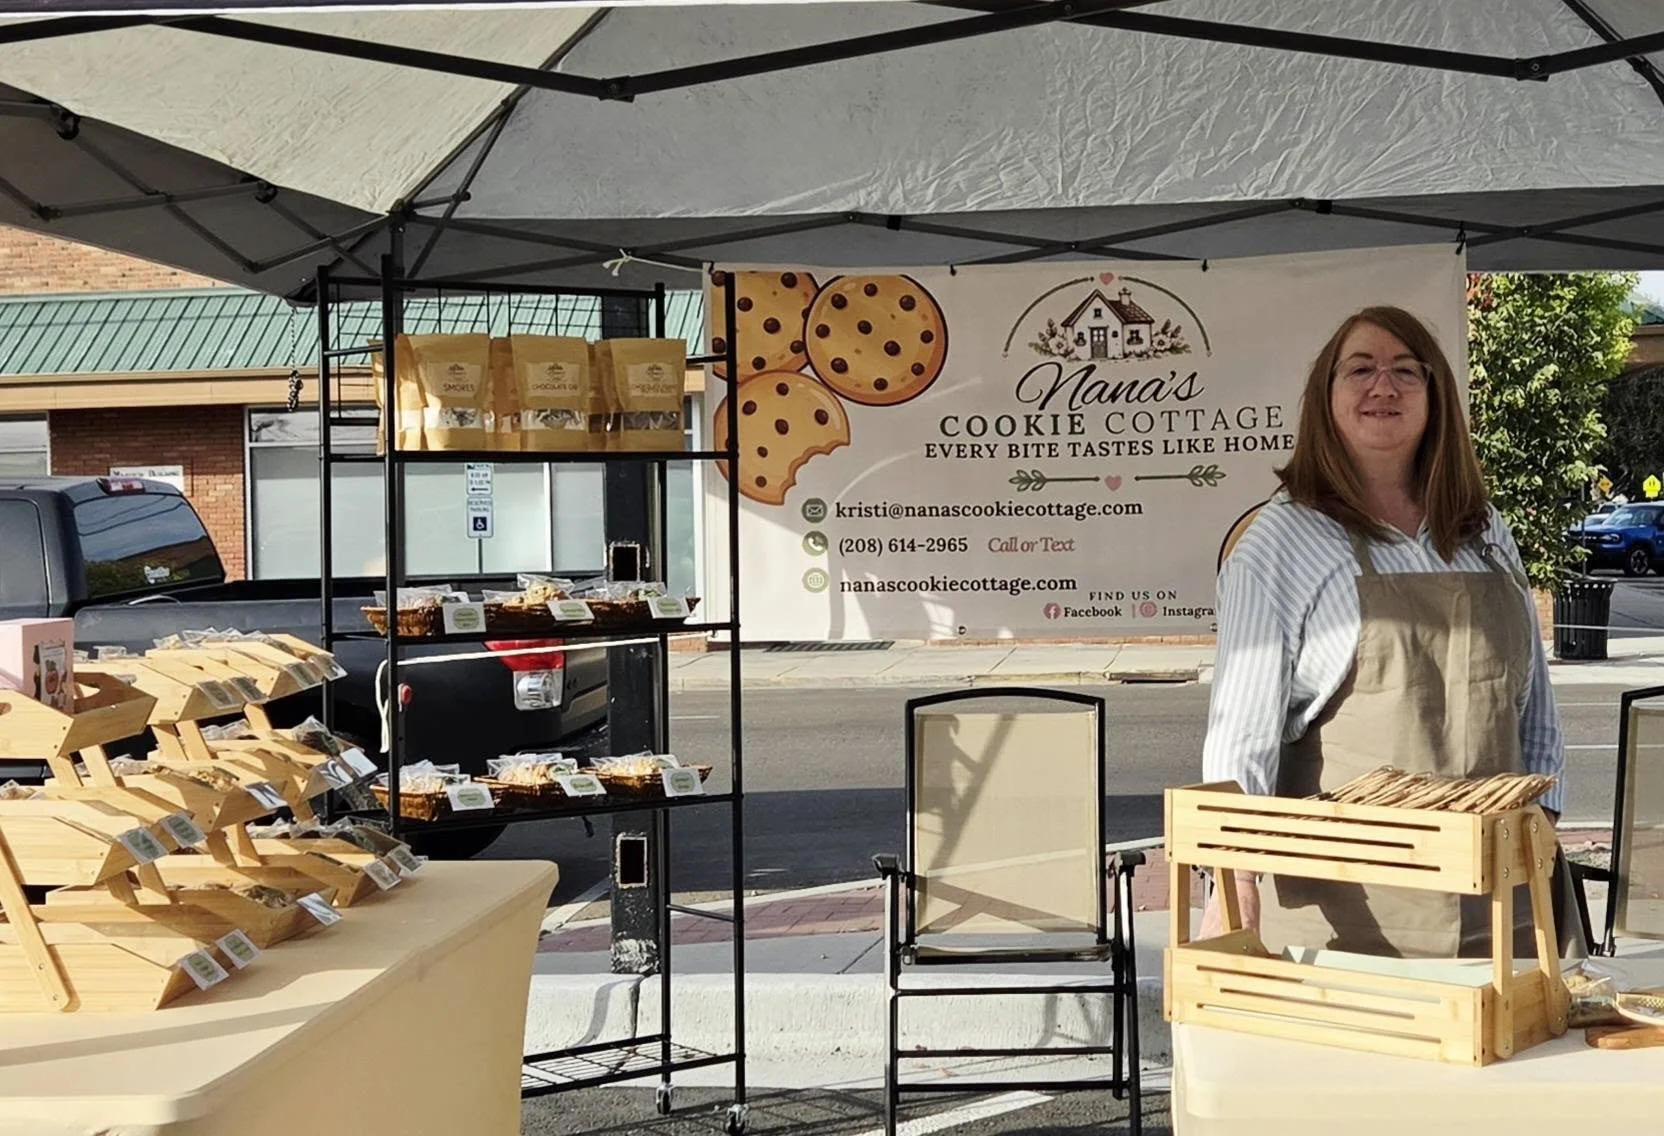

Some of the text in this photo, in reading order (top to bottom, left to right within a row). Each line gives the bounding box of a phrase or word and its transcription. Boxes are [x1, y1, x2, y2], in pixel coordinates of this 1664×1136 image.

[1015, 361, 1205, 412] Nana's
[939, 405, 1284, 438] COOKIE COTTAGE
[925, 434, 1295, 459] EVERY BITE TASTES LIKE HOME
[835, 500, 1143, 521] kristi@nanascookiecottage.com
[839, 537, 1076, 557] (208) 614-2965 Call or Text
[840, 575, 1077, 596] nanascookiecottage.com
[1089, 590, 1177, 601] FIND US ON
[1063, 606, 1216, 619] Facebook Instagra
